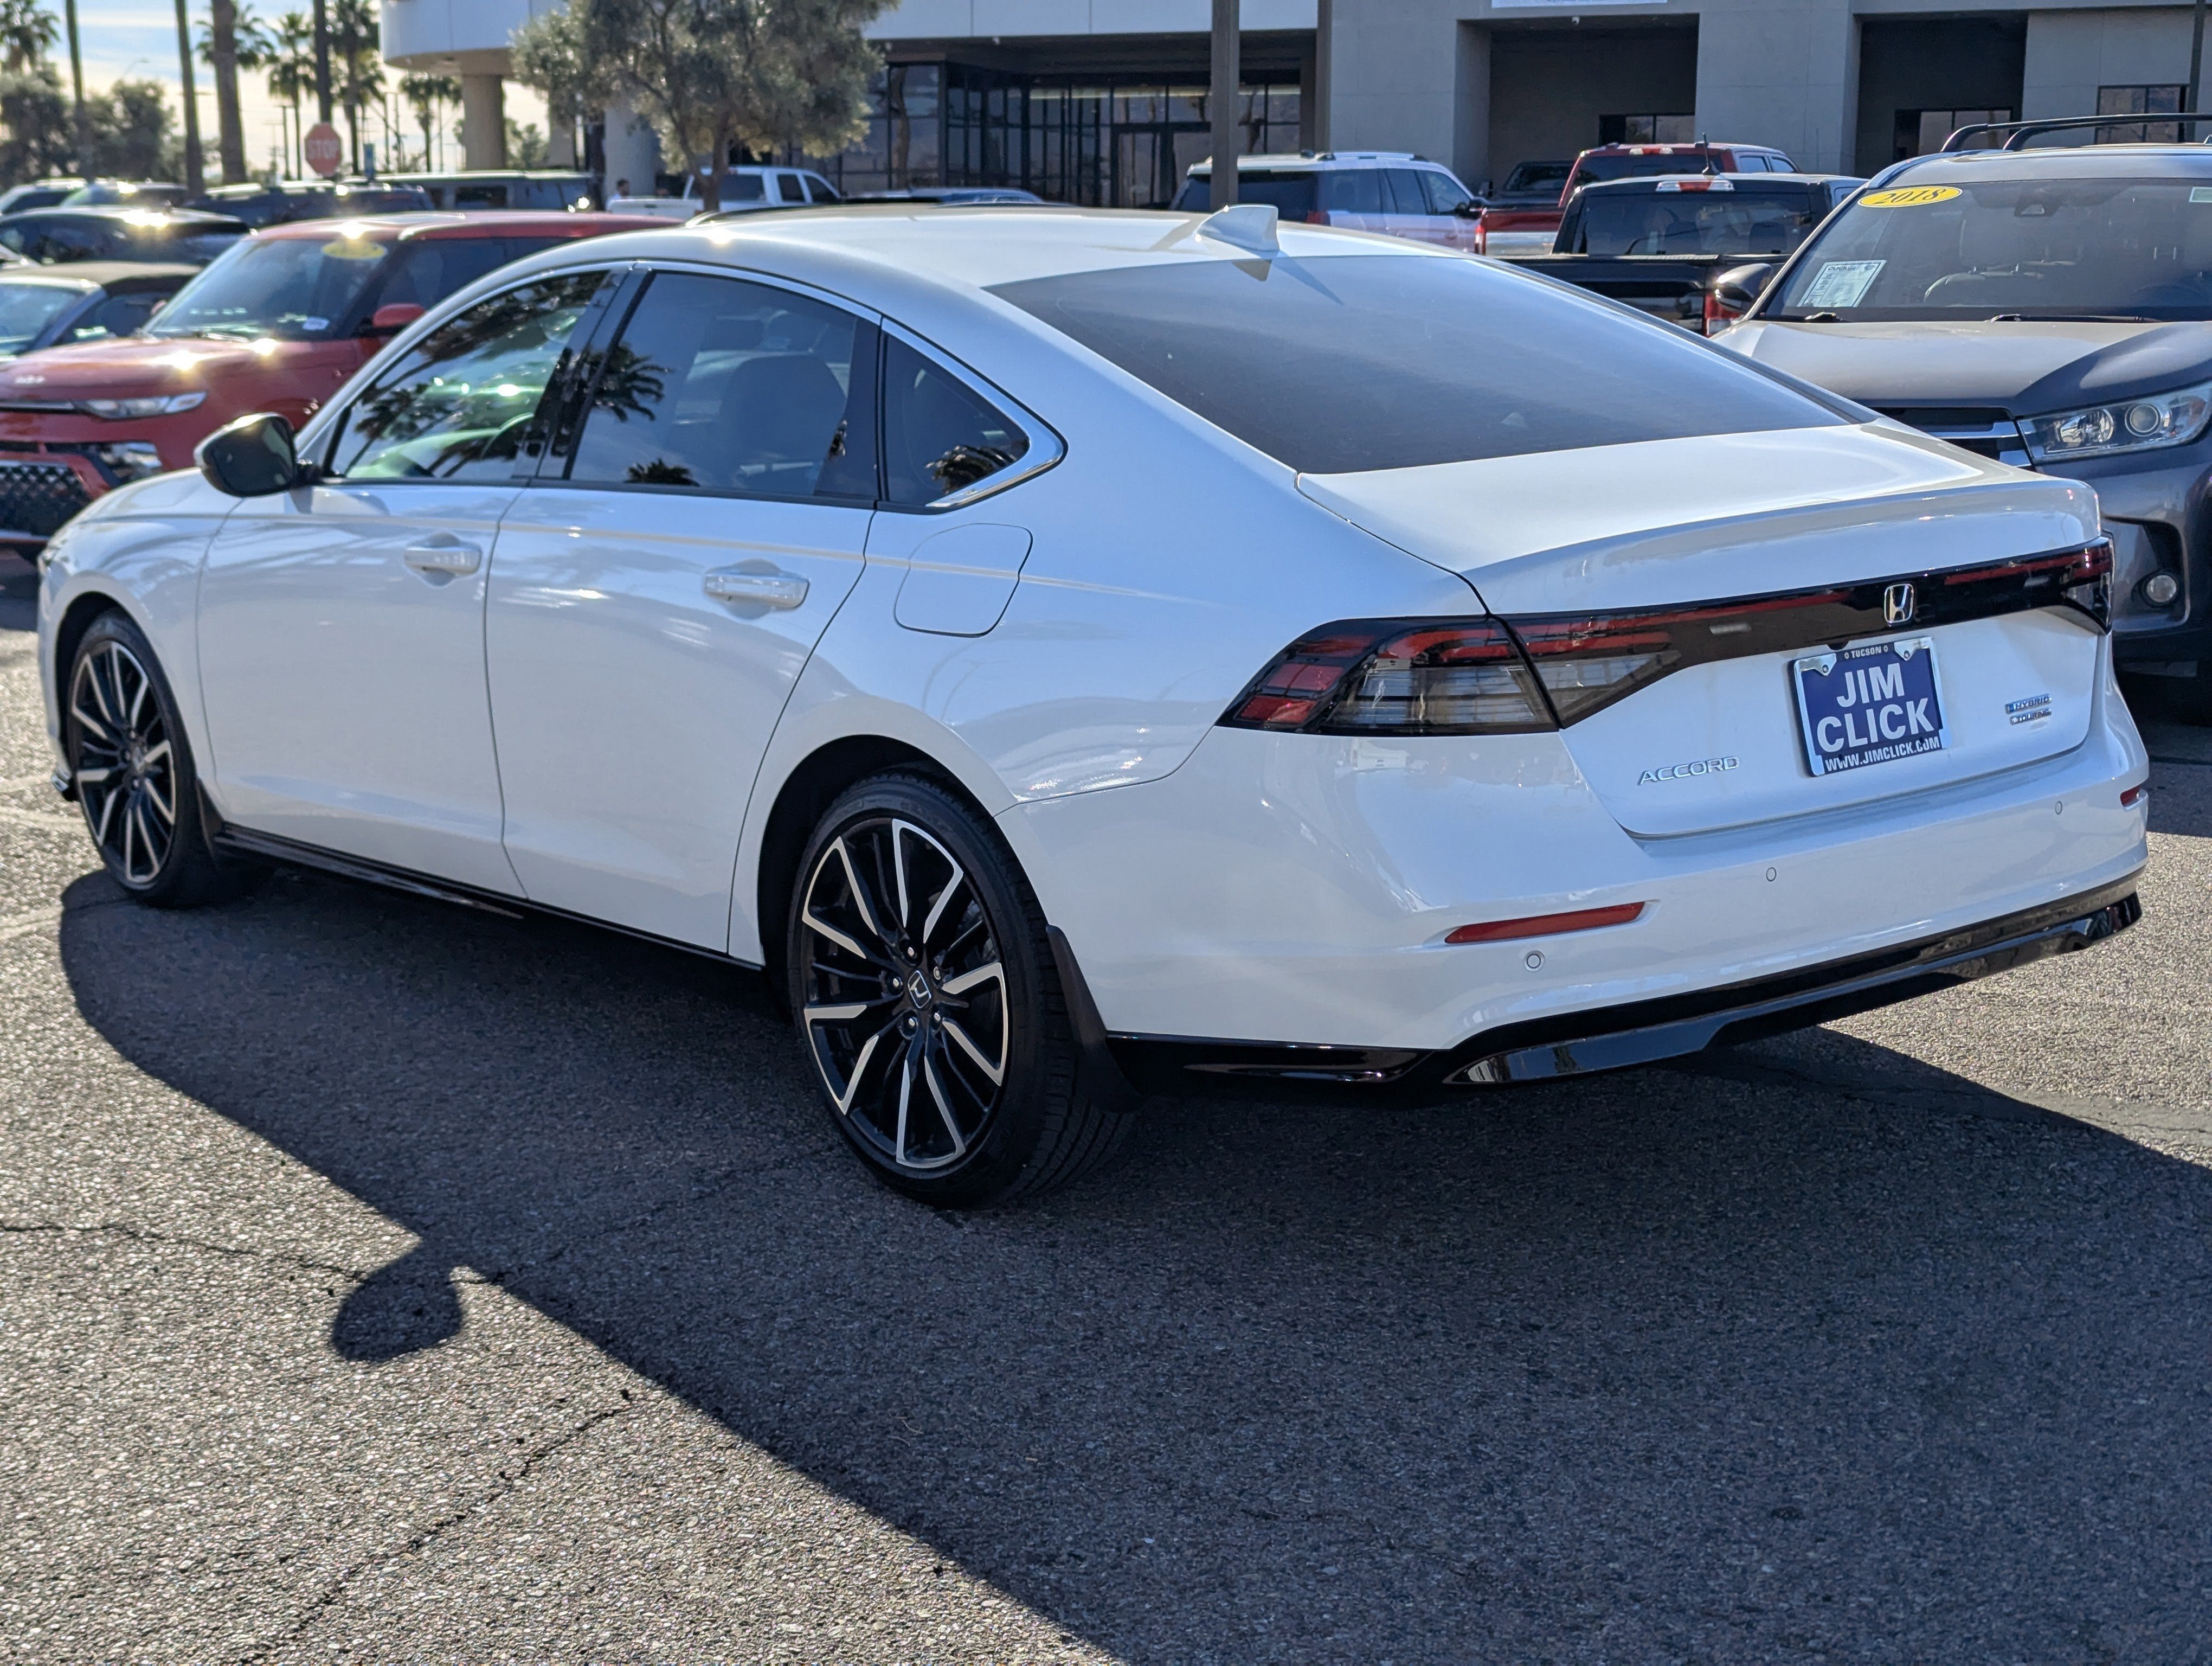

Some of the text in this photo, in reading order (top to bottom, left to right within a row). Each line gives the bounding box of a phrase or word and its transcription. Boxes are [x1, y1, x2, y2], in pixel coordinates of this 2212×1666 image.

[1872, 188, 1947, 205] 2018
[1850, 646, 1882, 658] TUCSON
[1836, 662, 1905, 707] JIM
[1817, 697, 1935, 752] CLICK
[1825, 736, 1940, 772] WWW.JIMCLICK.COM
[1637, 756, 1740, 786] ACCORD
